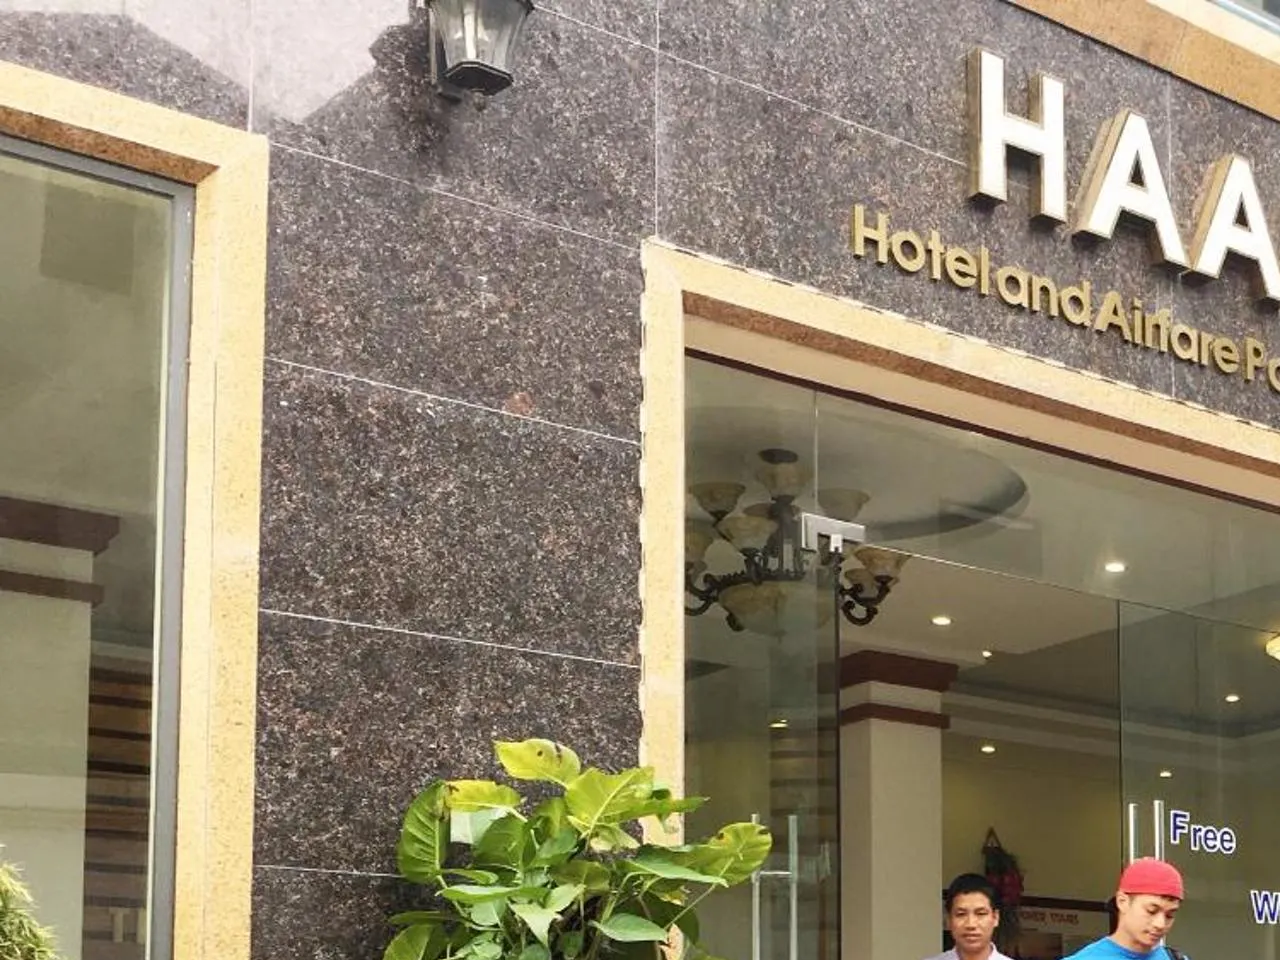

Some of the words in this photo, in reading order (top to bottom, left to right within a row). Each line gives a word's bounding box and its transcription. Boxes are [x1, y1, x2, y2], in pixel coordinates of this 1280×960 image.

[851, 203, 989, 296] Hotel
[996, 265, 1092, 328] and
[1093, 290, 1240, 373] Airfare
[1170, 810, 1236, 854] Free
